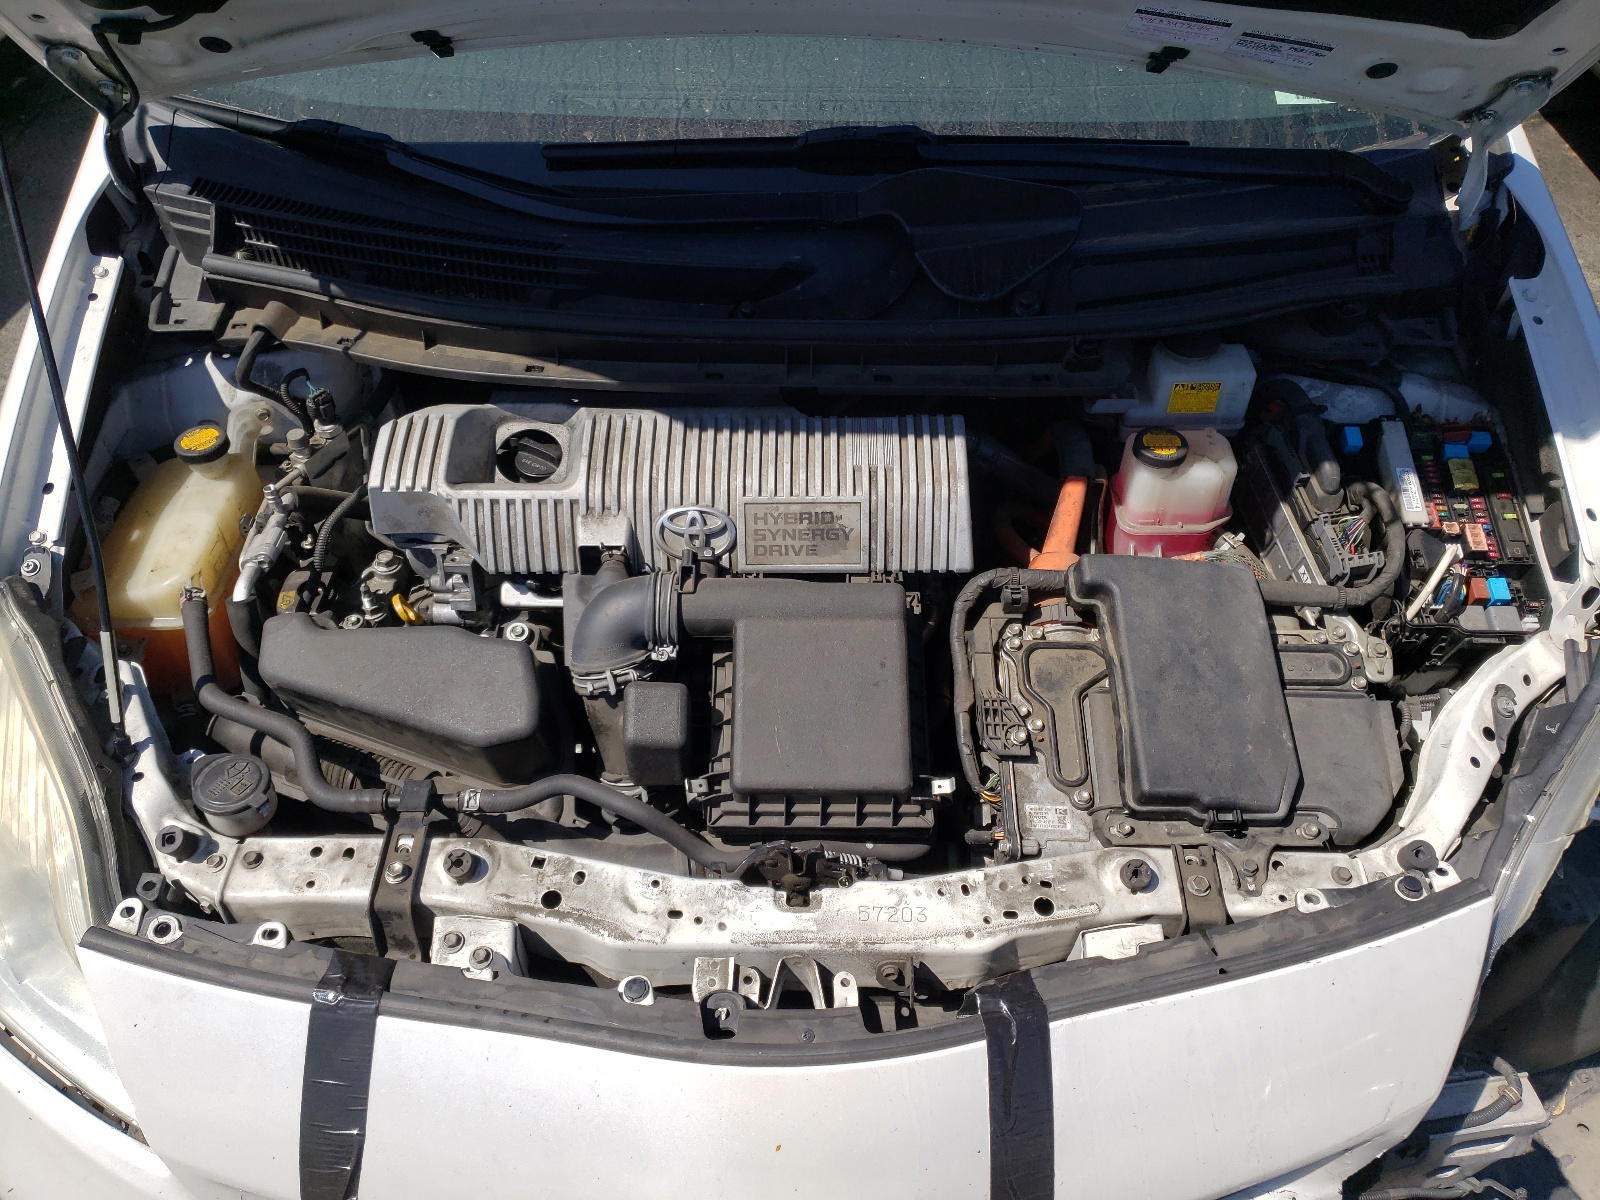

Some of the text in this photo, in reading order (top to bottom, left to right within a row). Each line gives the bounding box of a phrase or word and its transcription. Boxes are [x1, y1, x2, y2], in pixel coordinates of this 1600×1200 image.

[753, 511, 835, 526] HYBRID
[753, 528, 855, 542] SYNERGY
[753, 544, 818, 557] DRIVE
[858, 905, 928, 923] 57203
